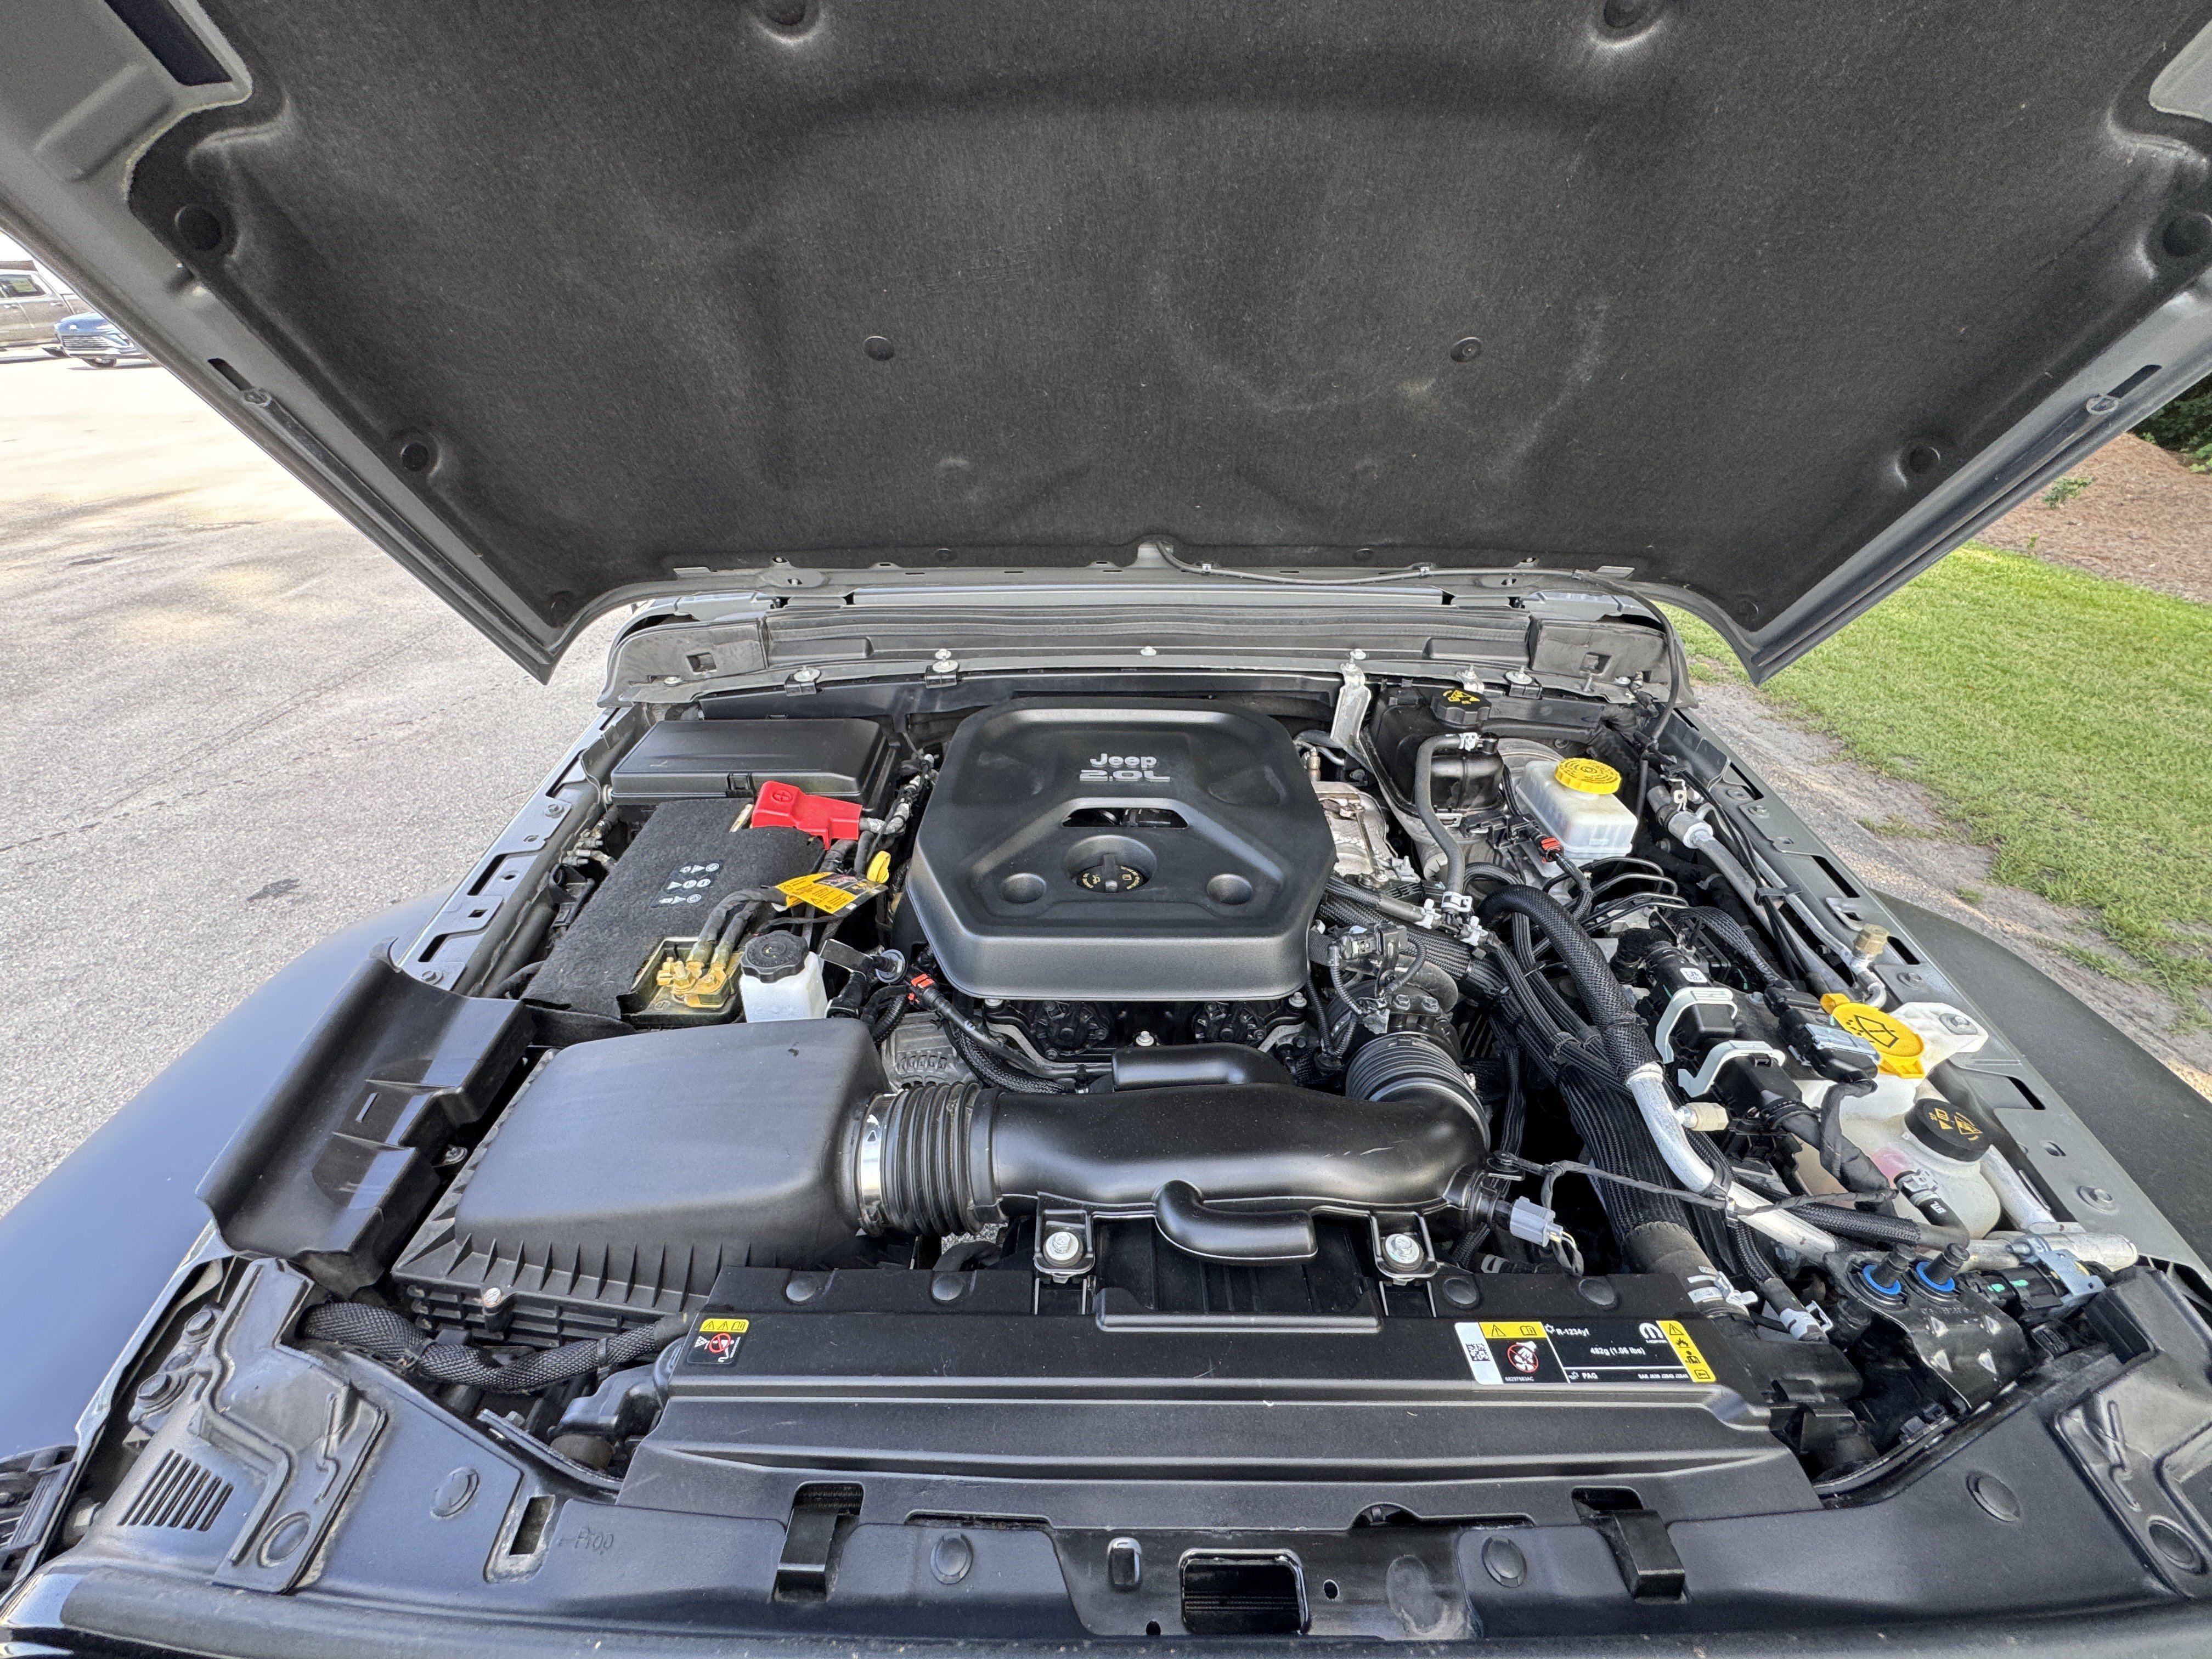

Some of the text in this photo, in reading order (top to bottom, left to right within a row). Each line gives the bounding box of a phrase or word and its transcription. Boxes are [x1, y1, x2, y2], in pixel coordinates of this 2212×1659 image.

[1090, 753, 1158, 770] Jeep
[1079, 769, 1171, 783] 2.0L
[1555, 1328, 1590, 1337] R-1234yf
[1590, 1347, 1610, 1356] 482g
[1629, 1347, 1646, 1356] lbs)
